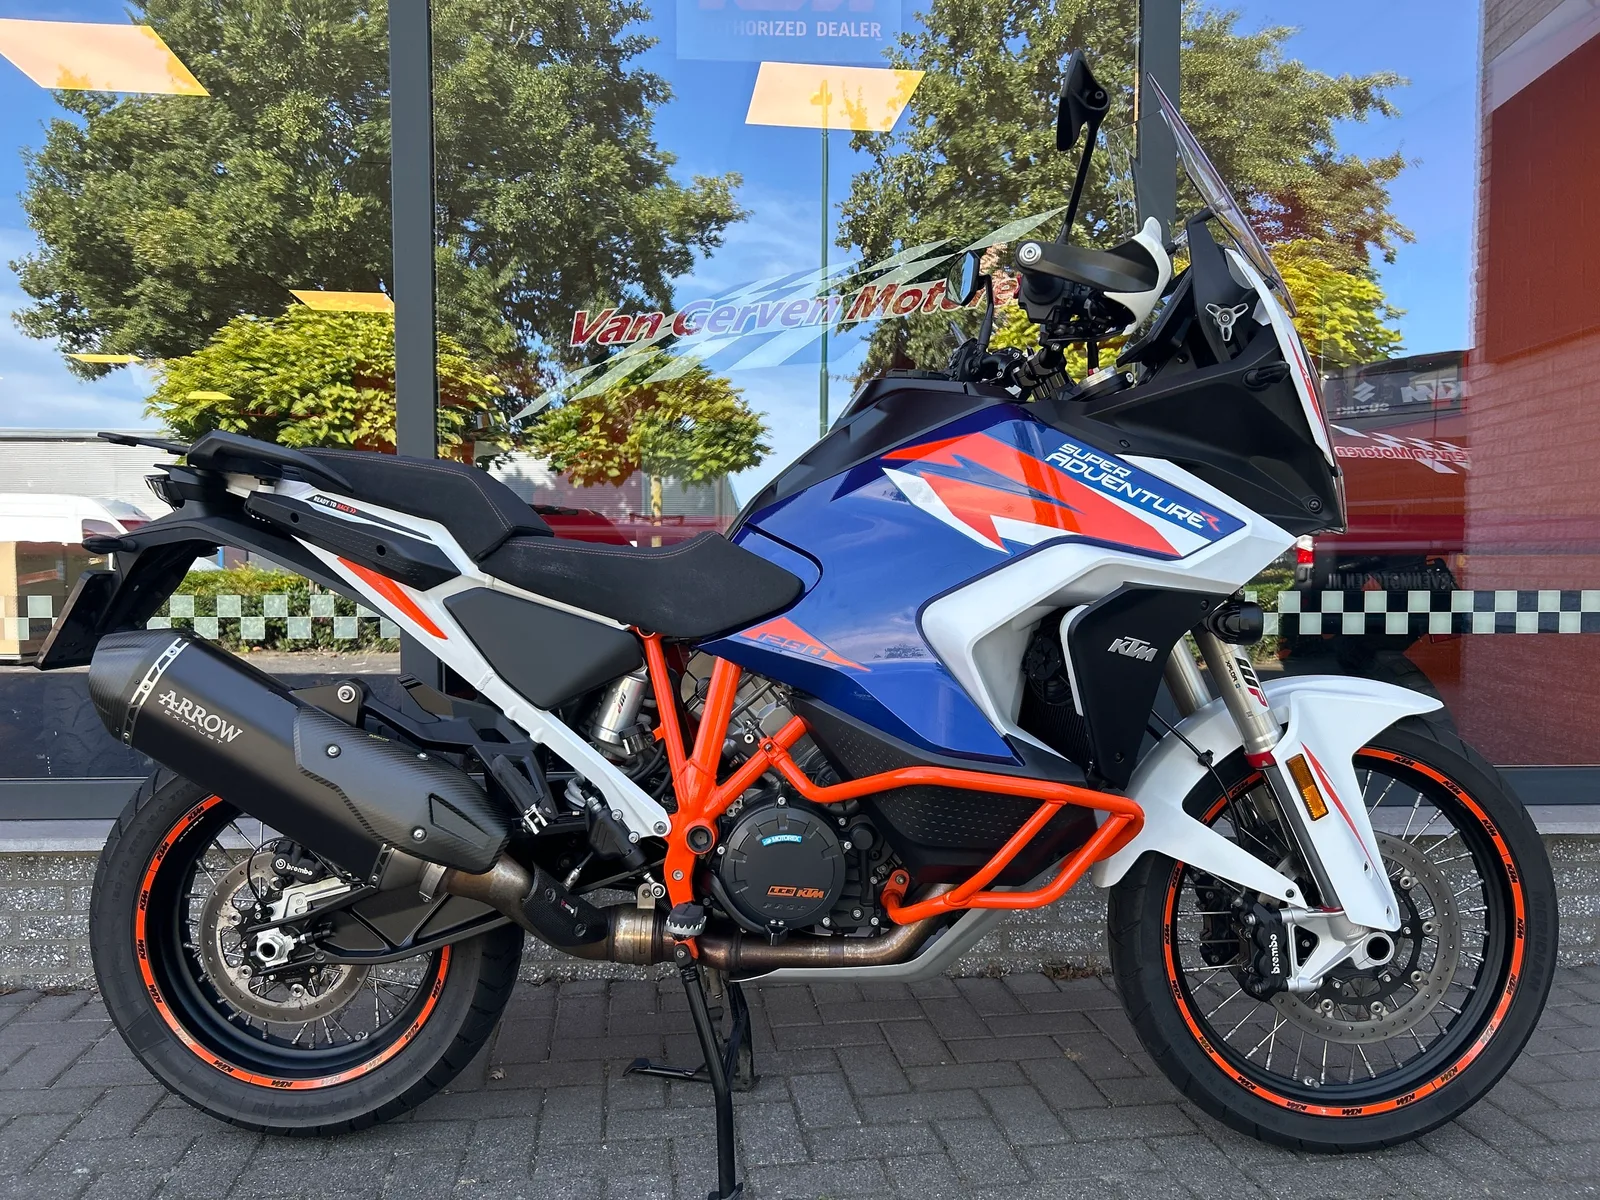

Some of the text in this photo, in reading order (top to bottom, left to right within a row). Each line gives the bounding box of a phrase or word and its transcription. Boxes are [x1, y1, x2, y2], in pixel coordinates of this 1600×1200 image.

[816, 21, 882, 38] DEALER
[570, 307, 665, 347] Van
[672, 294, 842, 338] Gerven
[1058, 443, 1132, 478] SUPER
[313, 495, 330, 505] READY
[336, 503, 350, 512] RACE
[1044, 452, 1206, 528] ADVENTURE
[757, 632, 829, 658] 1290
[1107, 636, 1158, 662] KTM
[158, 690, 243, 742] ARROW
[164, 709, 223, 744] EXHAUST
[286, 863, 313, 876] brembo
[796, 887, 825, 899] KTM
[1269, 933, 1280, 974] brembo
